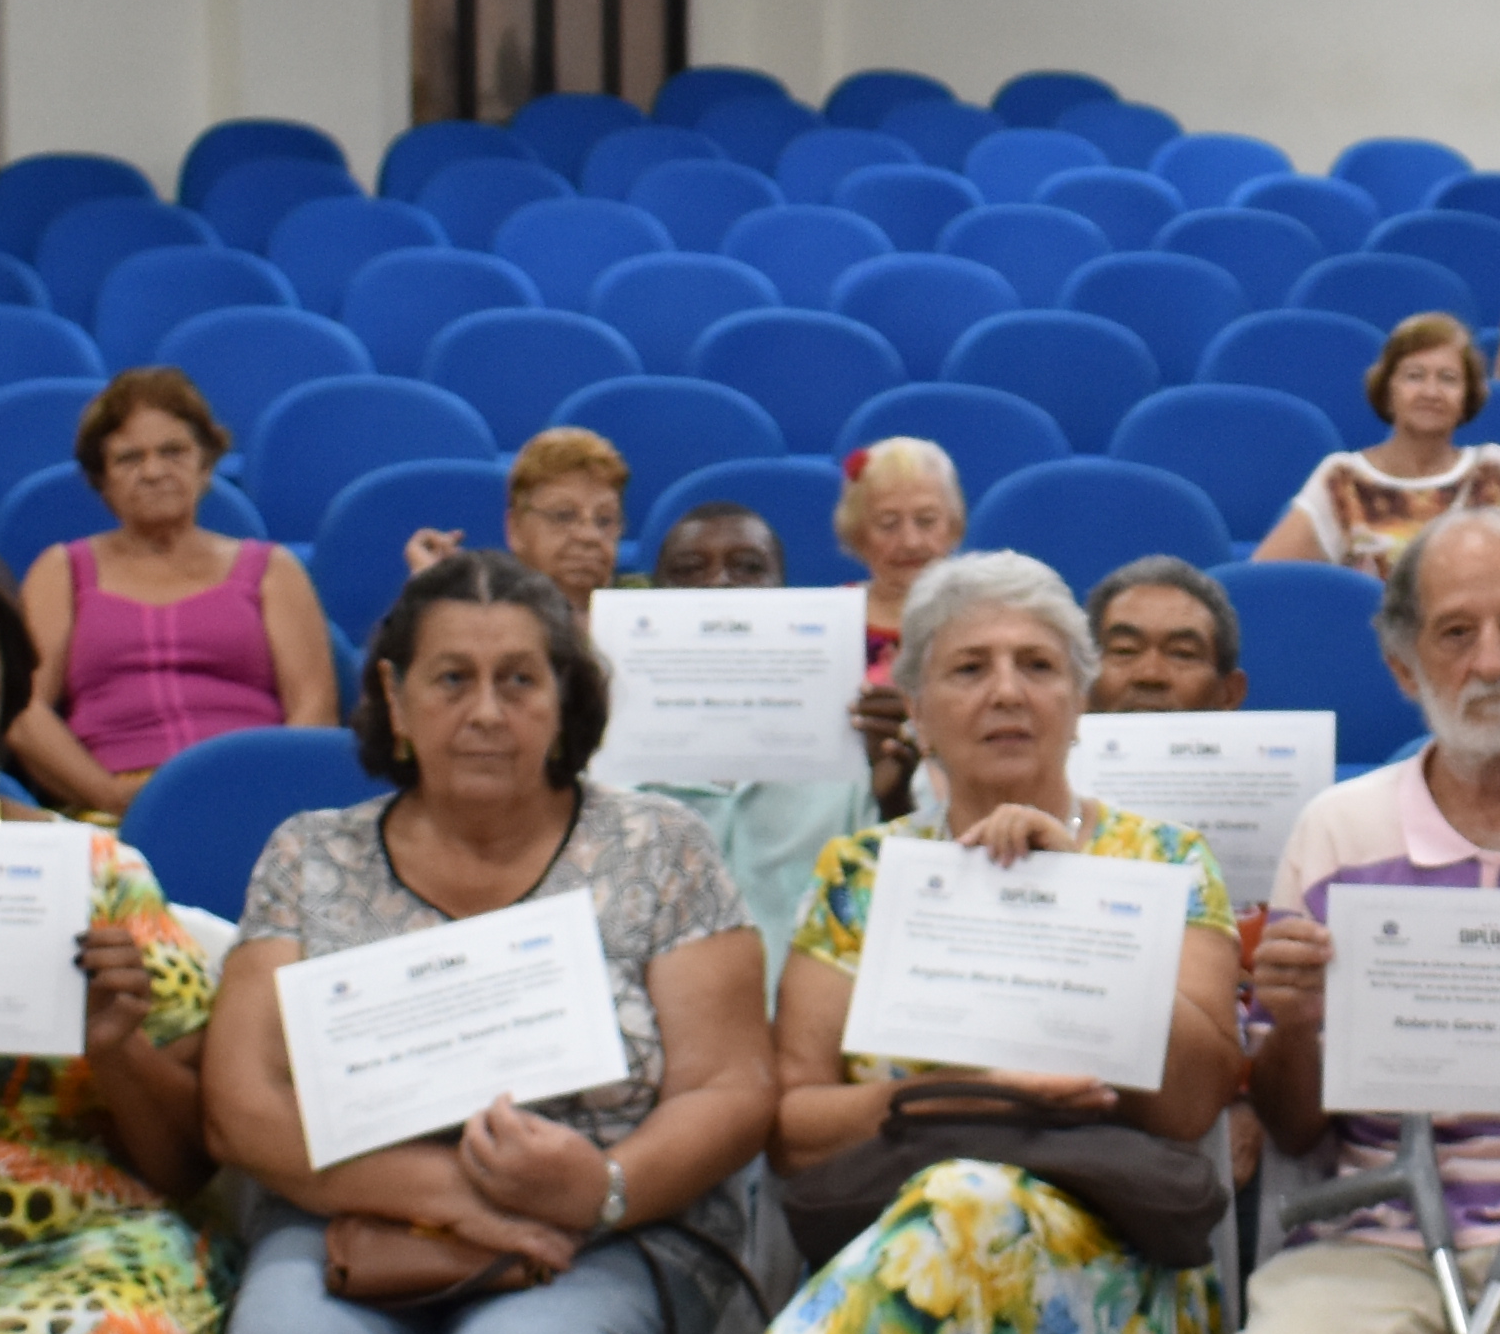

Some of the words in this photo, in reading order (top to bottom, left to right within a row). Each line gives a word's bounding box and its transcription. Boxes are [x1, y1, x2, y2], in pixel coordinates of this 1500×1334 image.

[1170, 744, 1221, 758] DIPLOMA
[1000, 888, 1056, 906] DIPLOMA
[407, 956, 467, 982] DIPLOMA
[1394, 1017, 1448, 1031] Roberto
